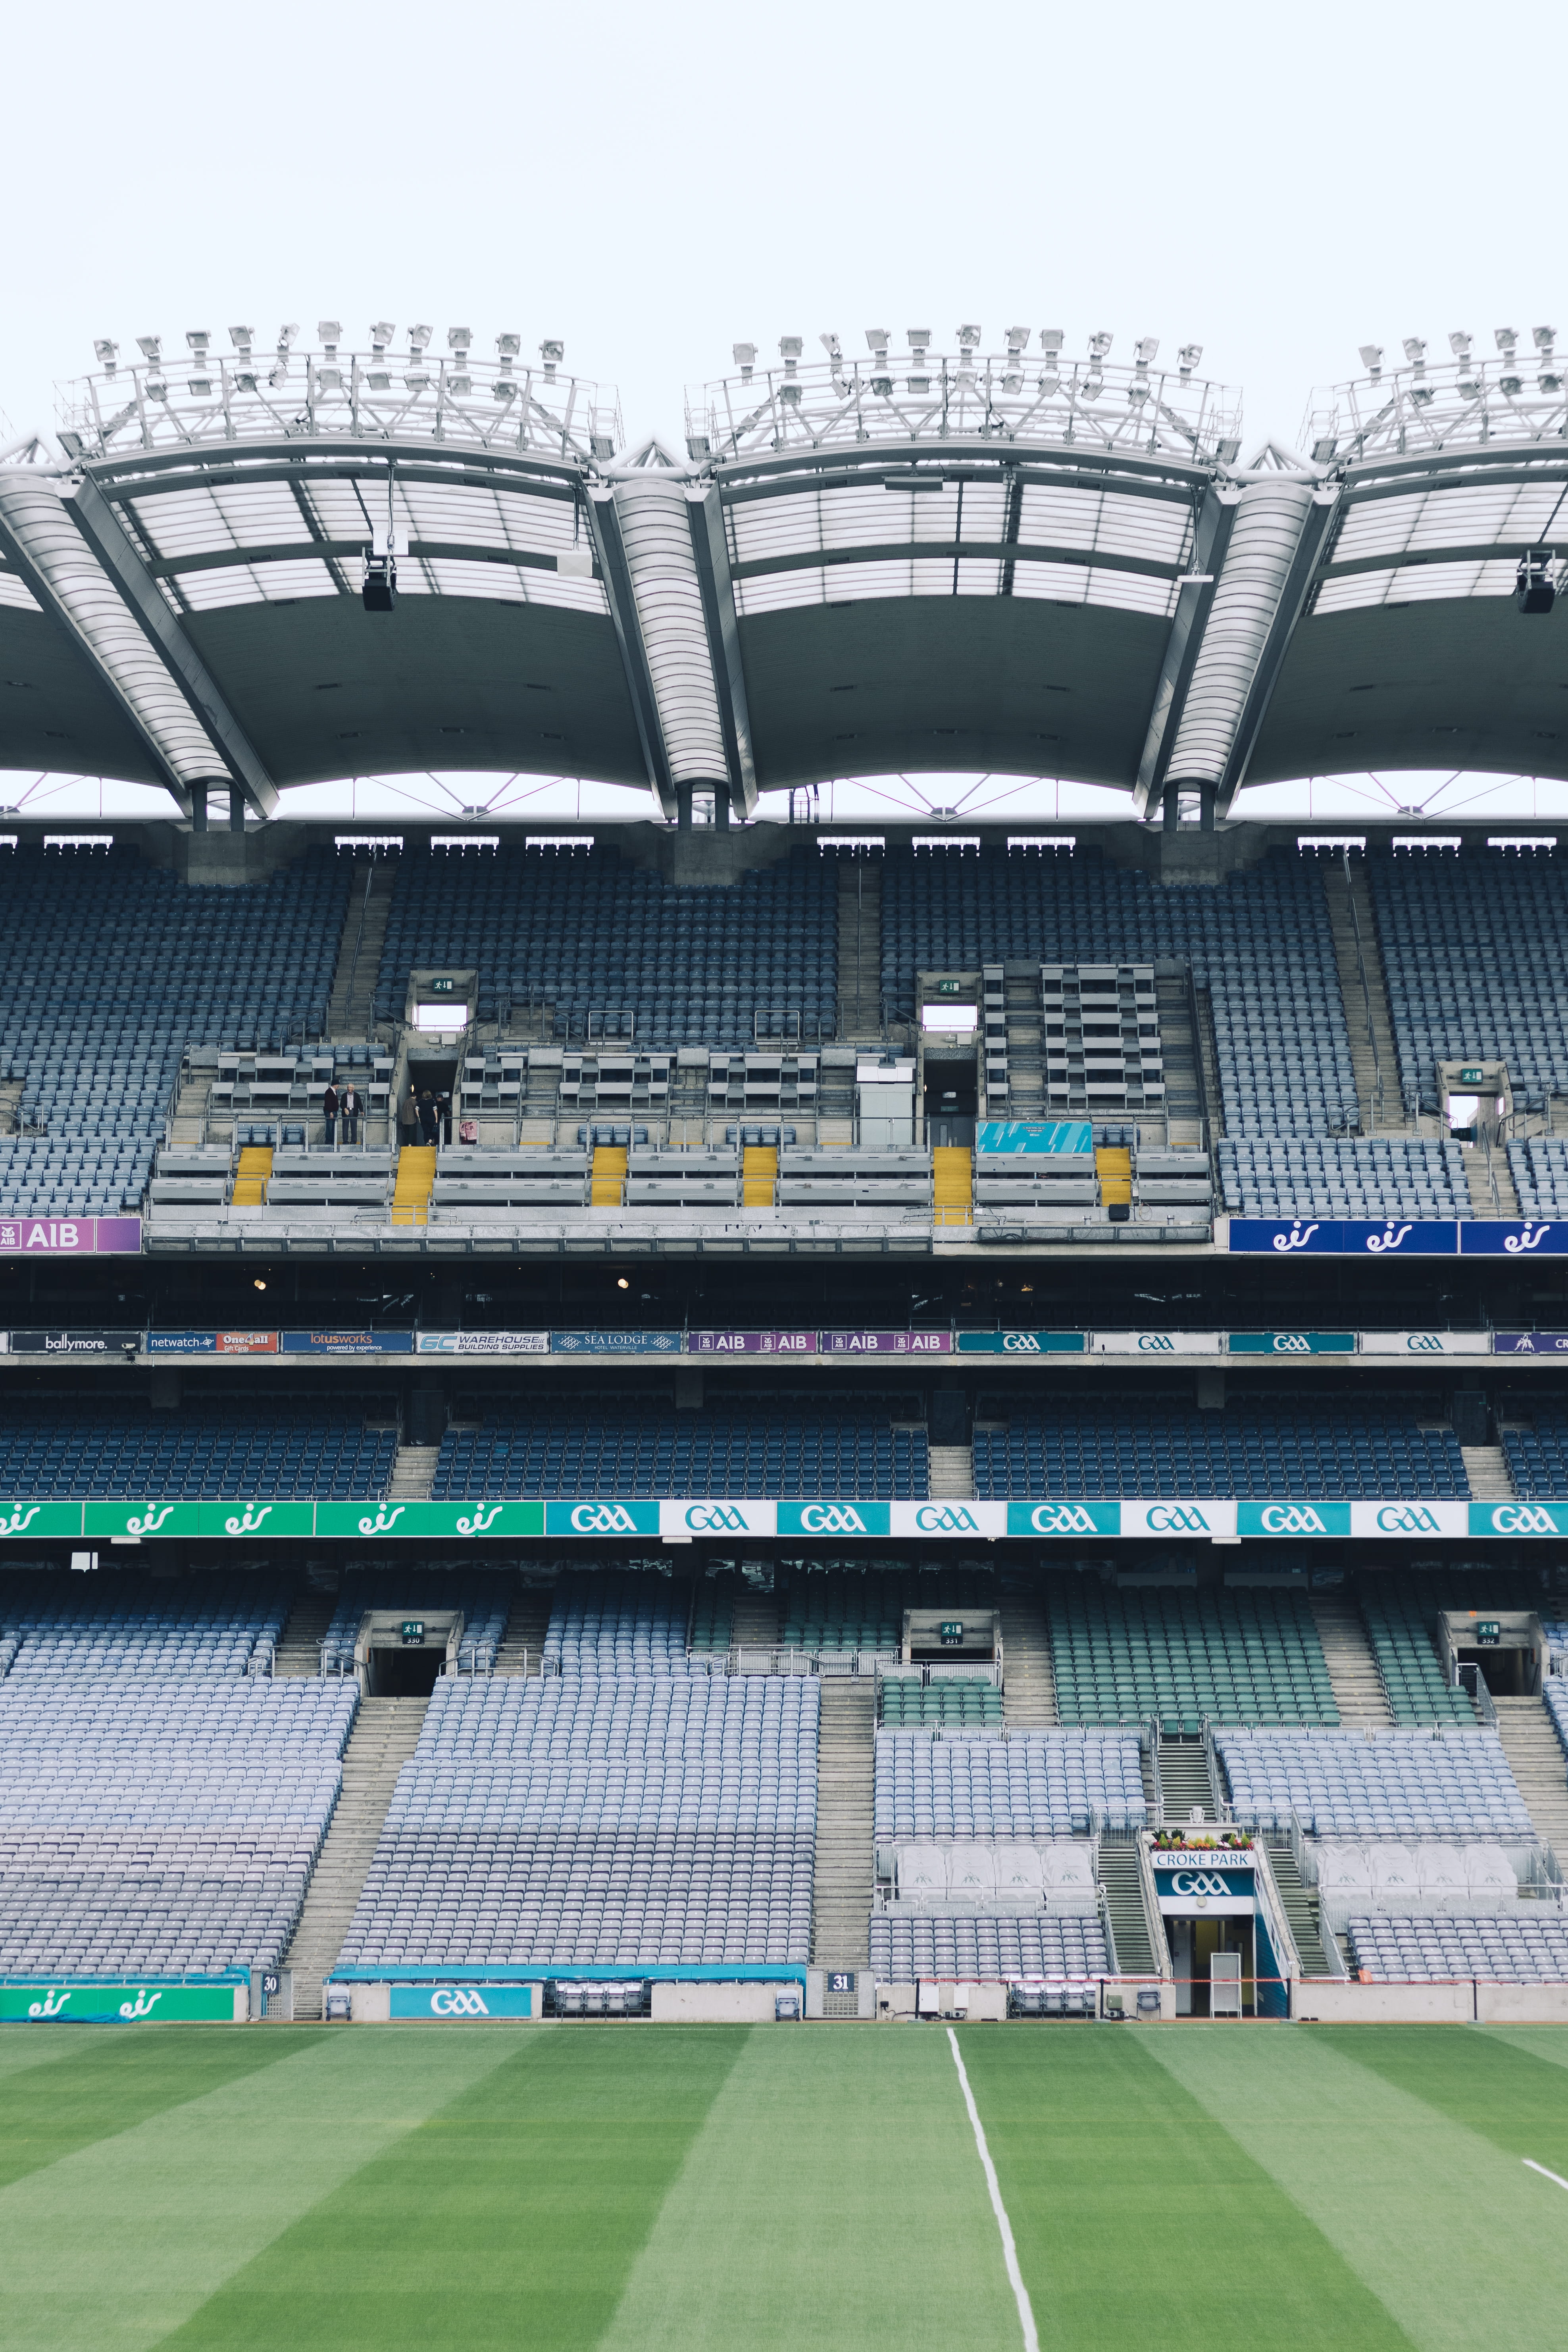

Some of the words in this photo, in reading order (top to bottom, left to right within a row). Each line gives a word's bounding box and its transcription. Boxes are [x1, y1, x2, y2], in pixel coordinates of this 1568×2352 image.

[26, 1223, 79, 1247] AIB
[46, 1333, 108, 1352] ballymore.
[151, 1338, 199, 1347] netwatch
[223, 1333, 269, 1345] One4all
[311, 1333, 372, 1344] lotusworks
[420, 1336, 458, 1349] GC
[585, 1336, 605, 1344] SEA
[608, 1336, 648, 1344] LODGE
[716, 1336, 745, 1349] AIB
[778, 1336, 807, 1349] AIB
[849, 1336, 878, 1349] AIB
[912, 1336, 941, 1349] AIB
[1157, 1854, 1206, 1865] CROKE
[1211, 1854, 1249, 1865] PARK
[264, 1976, 277, 1991] 30
[833, 1975, 848, 1989] 31
